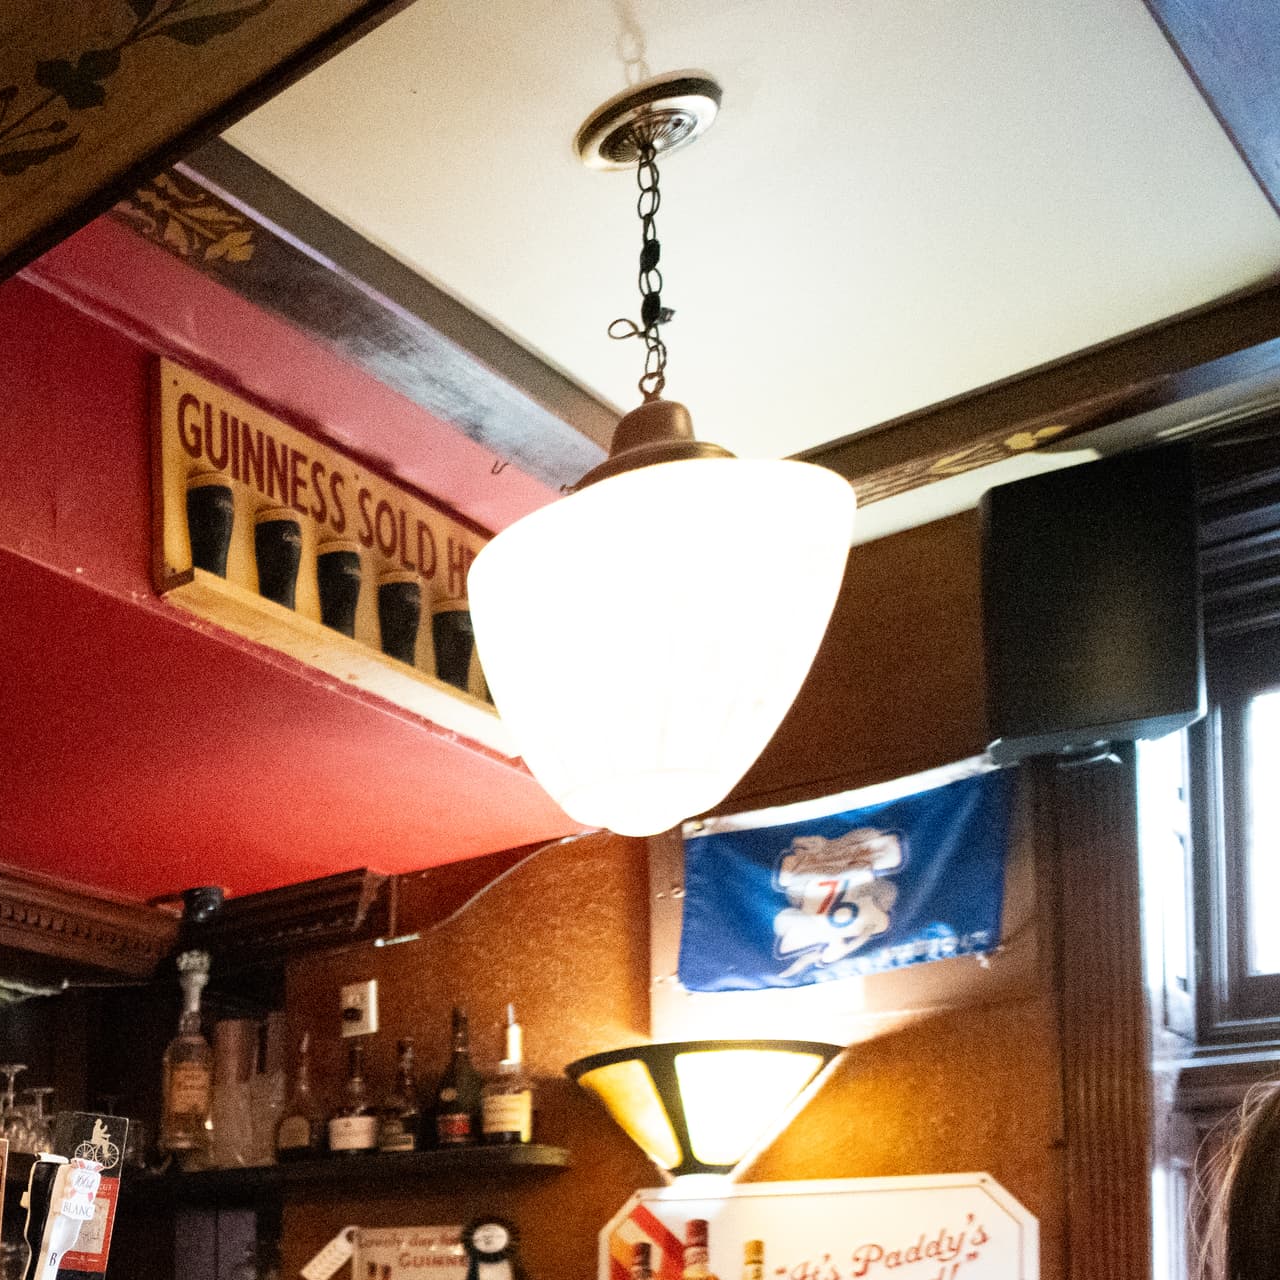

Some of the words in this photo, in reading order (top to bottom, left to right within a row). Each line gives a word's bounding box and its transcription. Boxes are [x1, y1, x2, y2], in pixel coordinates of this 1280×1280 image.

[176, 392, 348, 536] GUINNESS
[357, 487, 438, 582] SOLD
[816, 880, 860, 929] 76
[62, 1200, 94, 1218] BLANC
[852, 1213, 991, 1278] Paddy's
